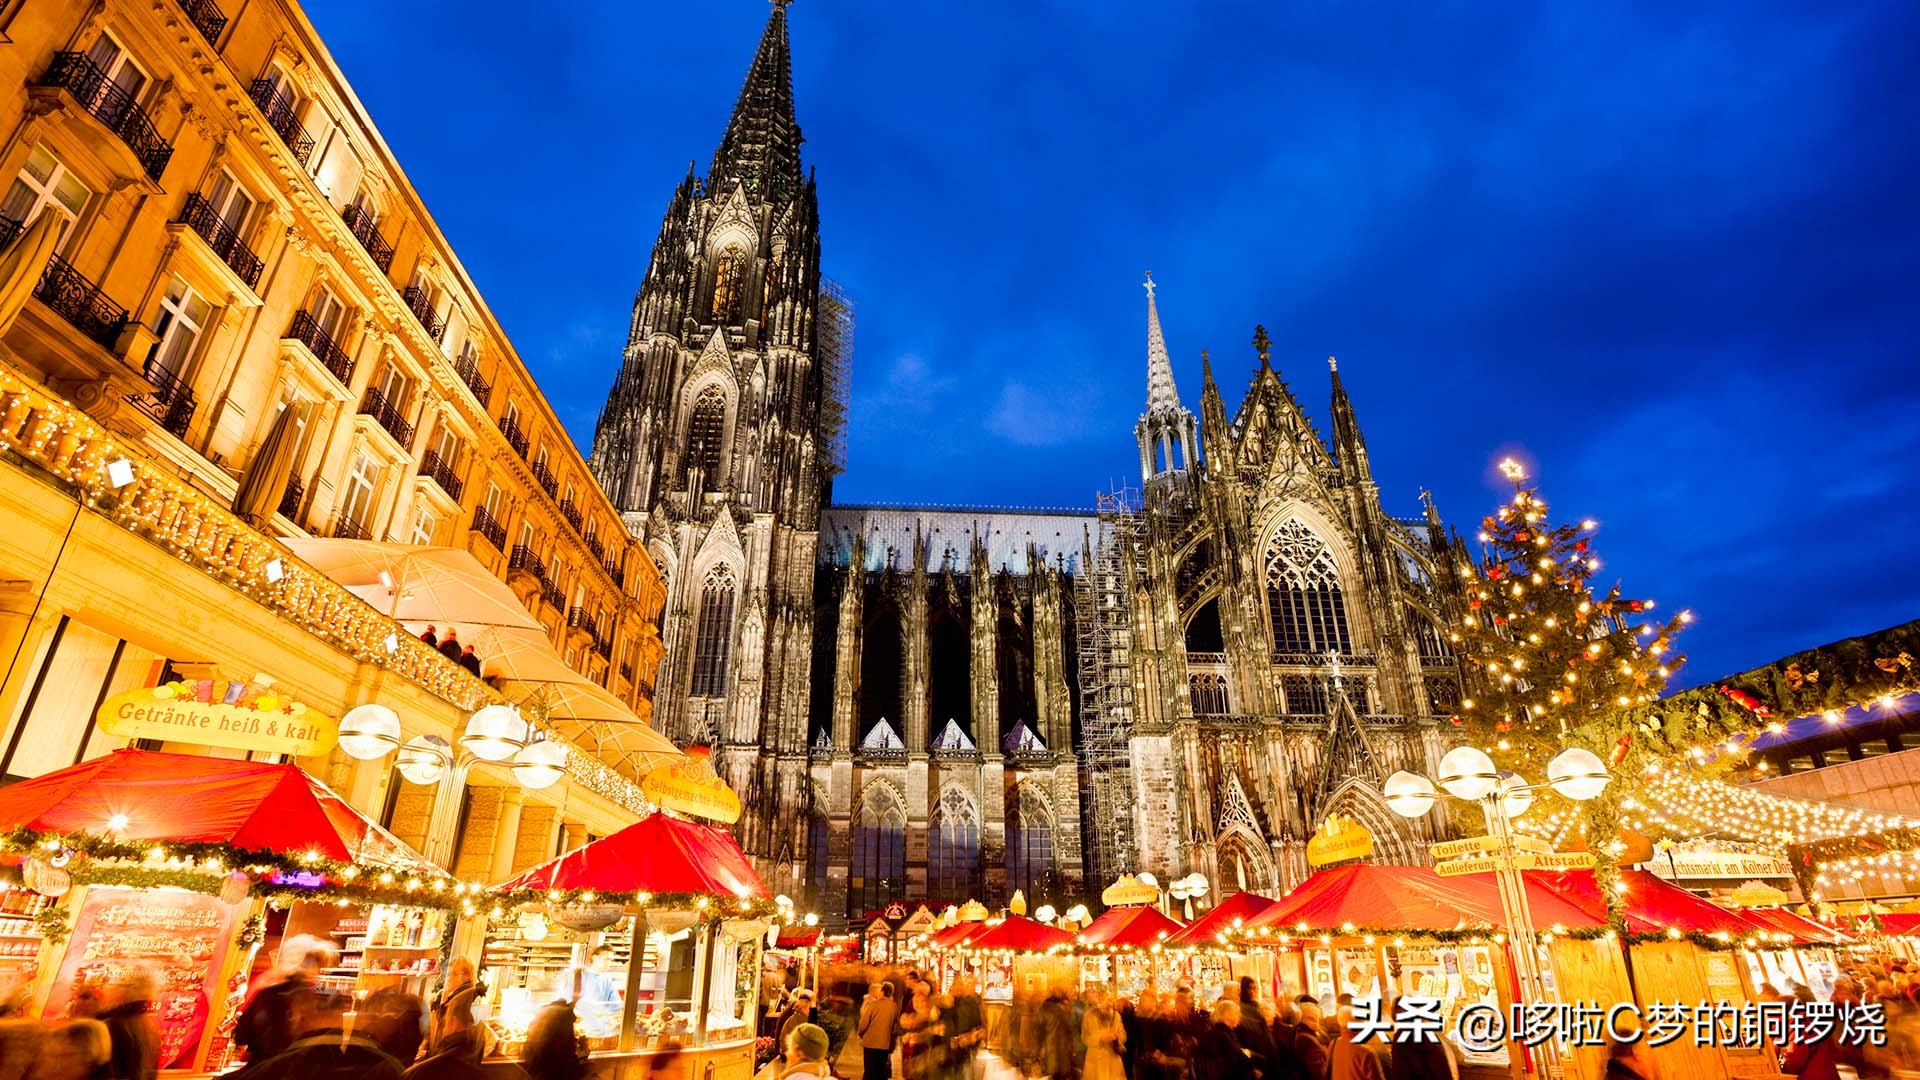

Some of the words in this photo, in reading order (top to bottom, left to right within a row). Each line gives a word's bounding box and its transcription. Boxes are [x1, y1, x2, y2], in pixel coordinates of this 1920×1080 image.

[117, 702, 210, 728] Getränke
[219, 714, 260, 734] heiß
[266, 722, 278, 737] &
[285, 722, 321, 742] kalt
[1436, 841, 1481, 856] Toilette
[1439, 860, 1496, 876] Anlieferung
[1534, 856, 1591, 867] Altstadt
[1727, 863, 1739, 875] am
[1742, 859, 1771, 875] Kölner
